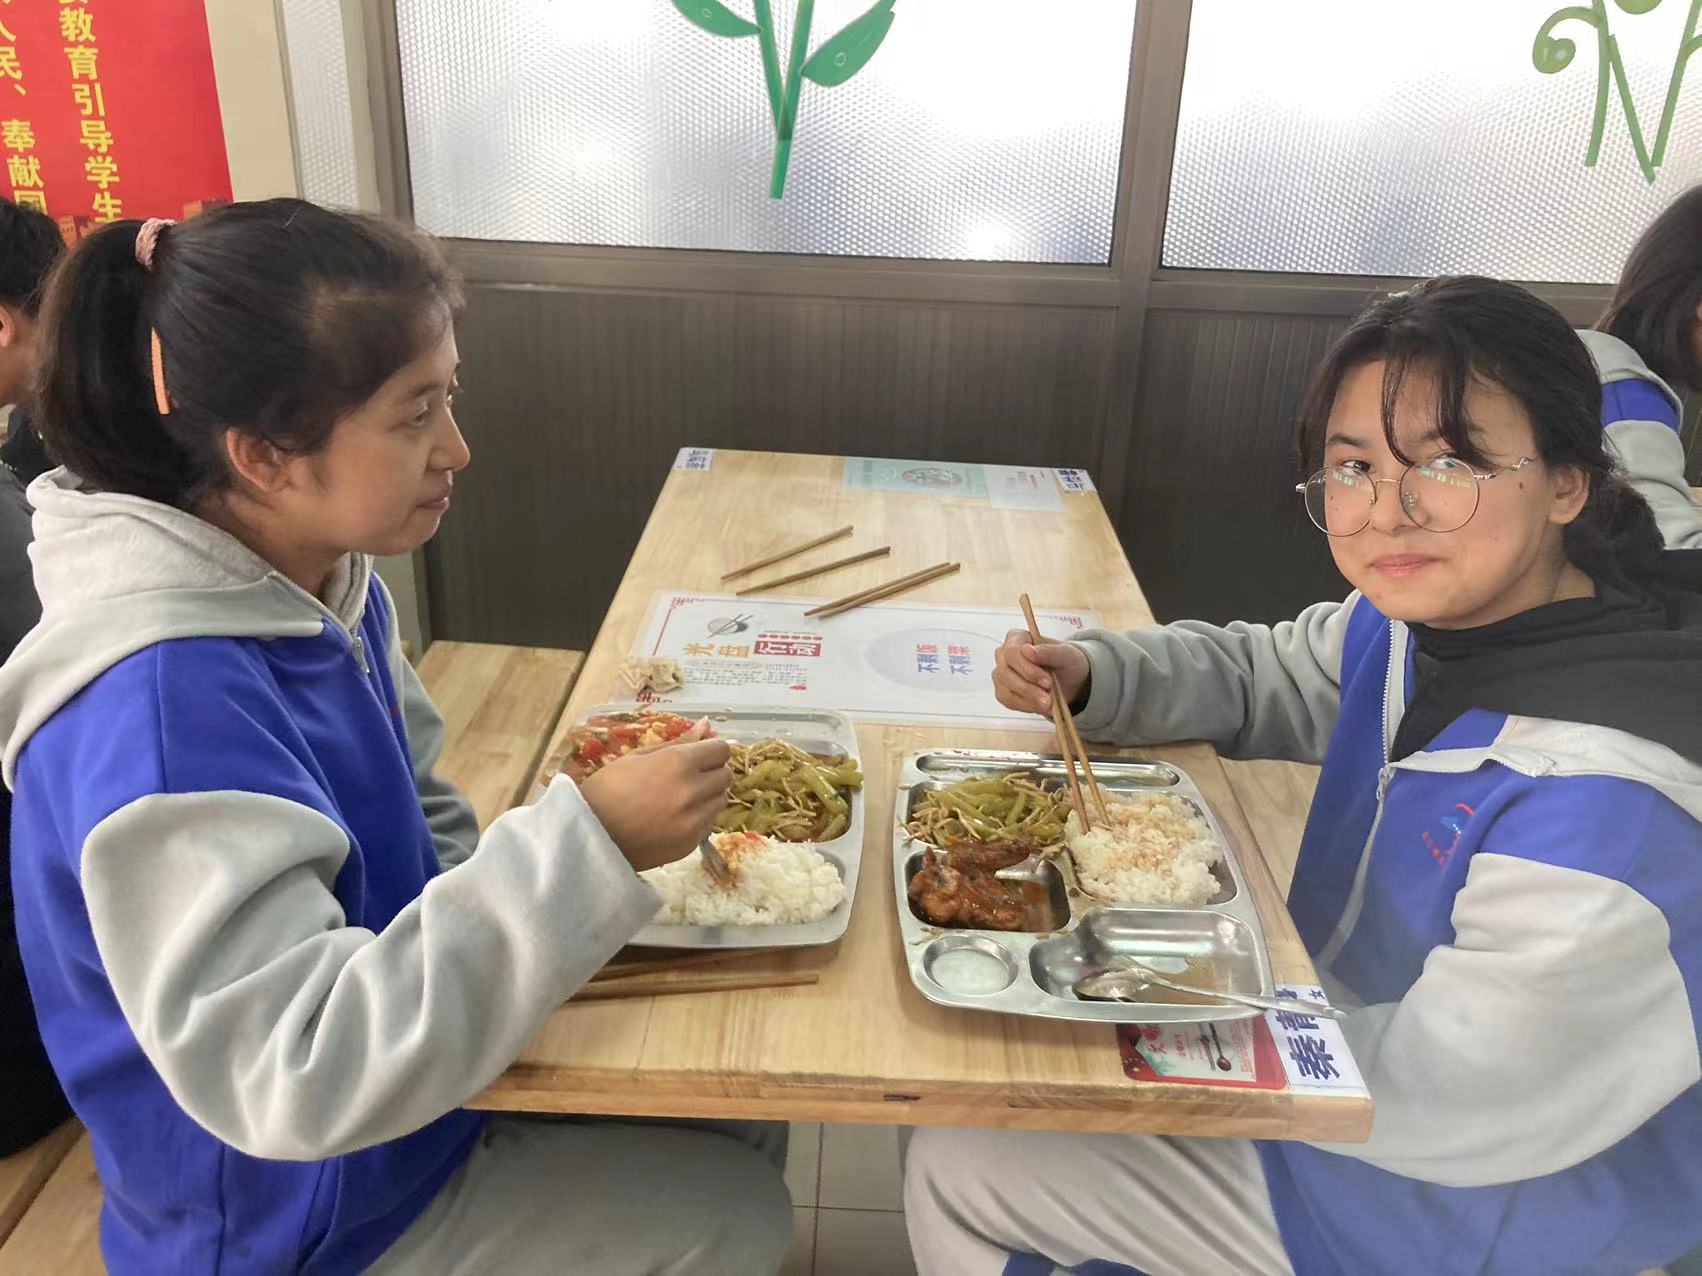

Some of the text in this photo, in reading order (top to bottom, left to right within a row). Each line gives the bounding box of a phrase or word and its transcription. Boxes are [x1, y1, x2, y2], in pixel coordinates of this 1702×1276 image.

[59, 0, 123, 223] 教育引导学生
